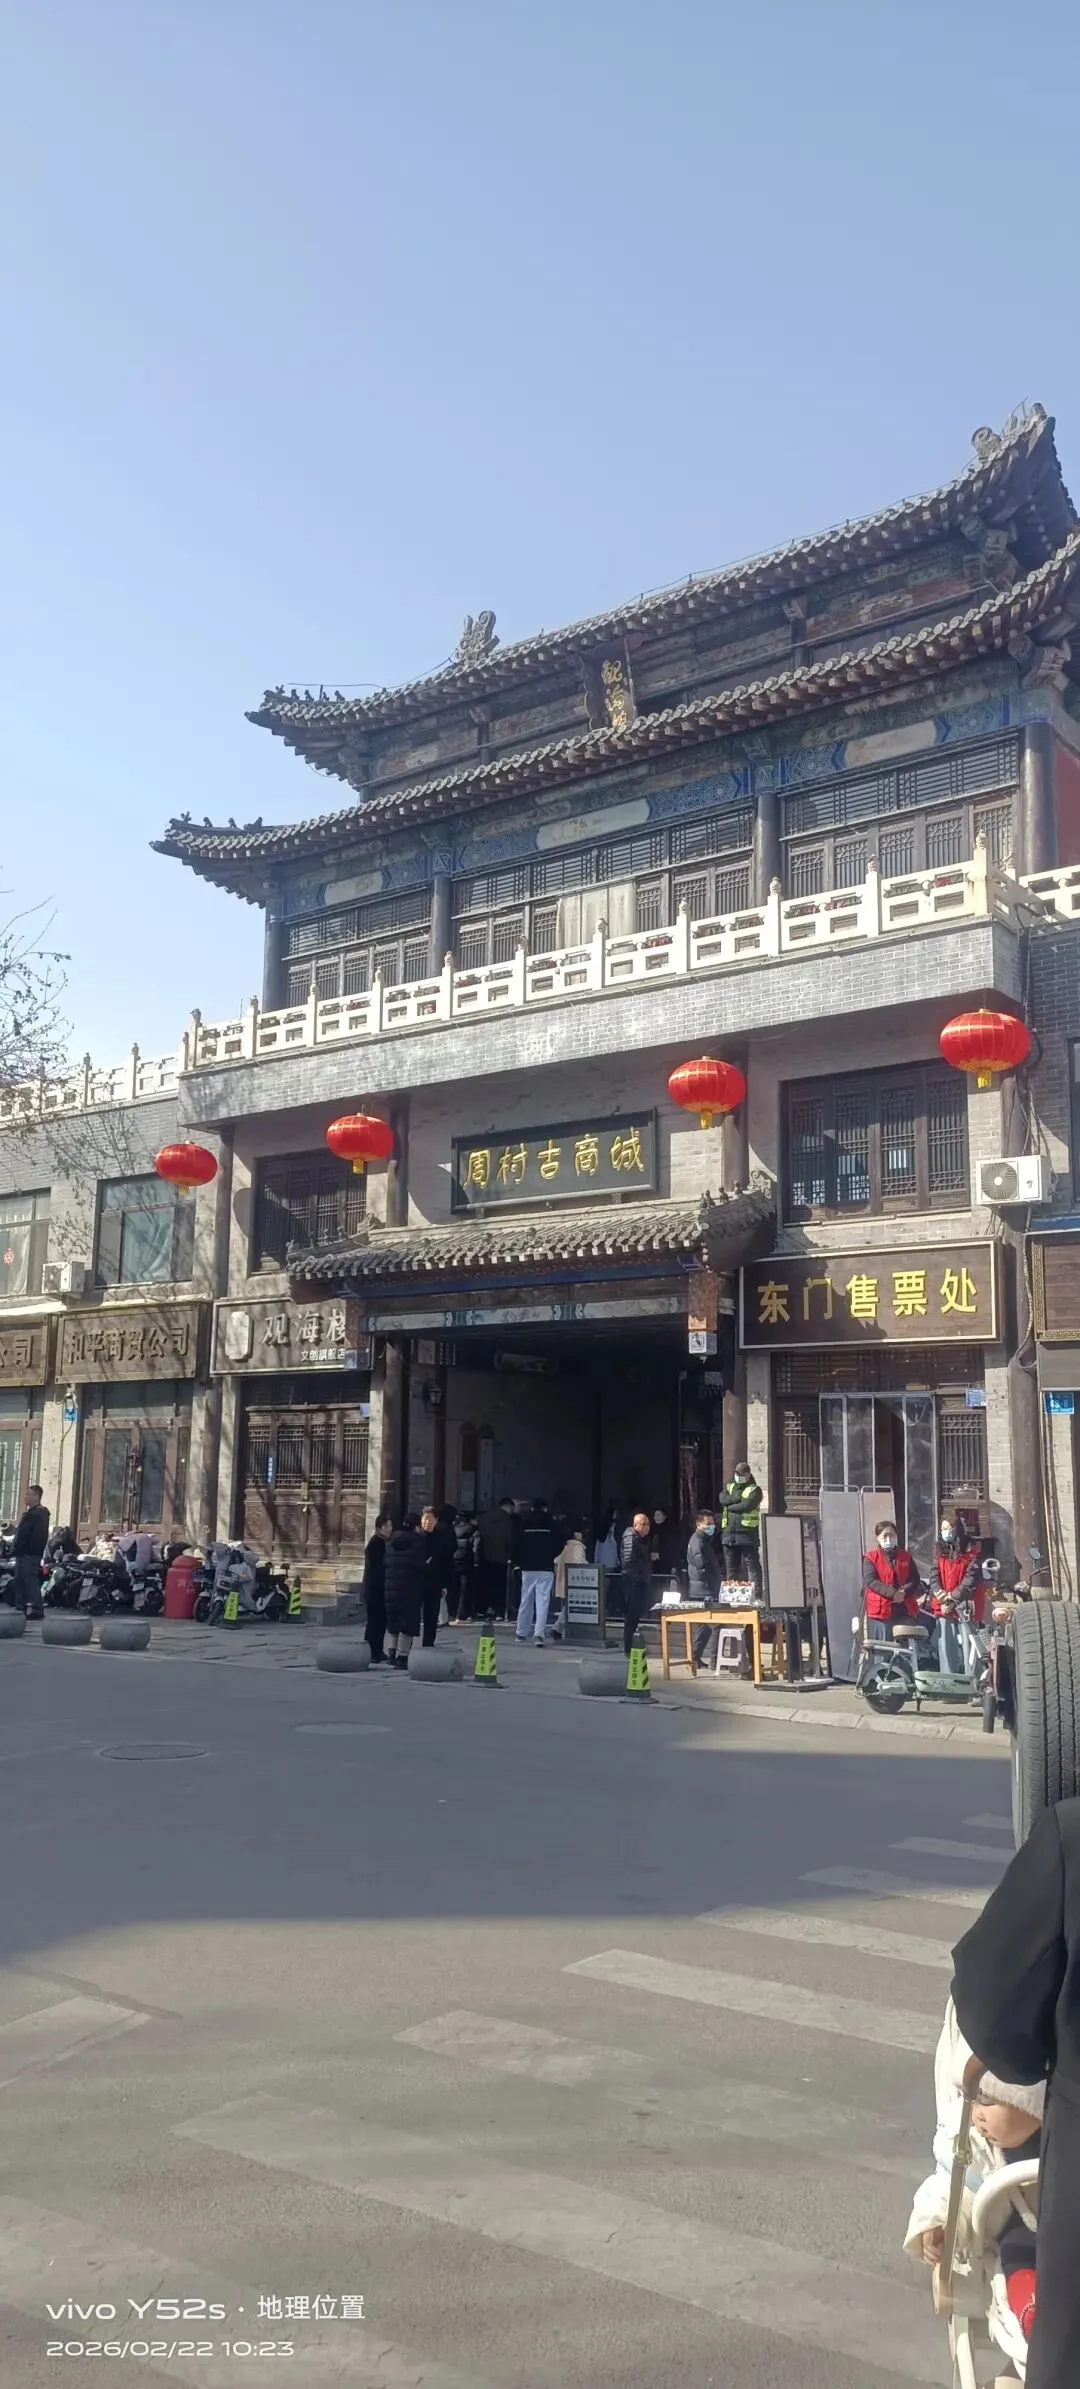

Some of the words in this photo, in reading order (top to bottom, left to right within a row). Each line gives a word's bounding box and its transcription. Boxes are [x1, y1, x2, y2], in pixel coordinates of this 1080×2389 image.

[463, 1126, 645, 1190] 周村古商城
[757, 1267, 978, 1324] 东门售票处
[67, 1322, 190, 1364] 和平商贸公司
[300, 1347, 346, 1361] 文创旗舰店
